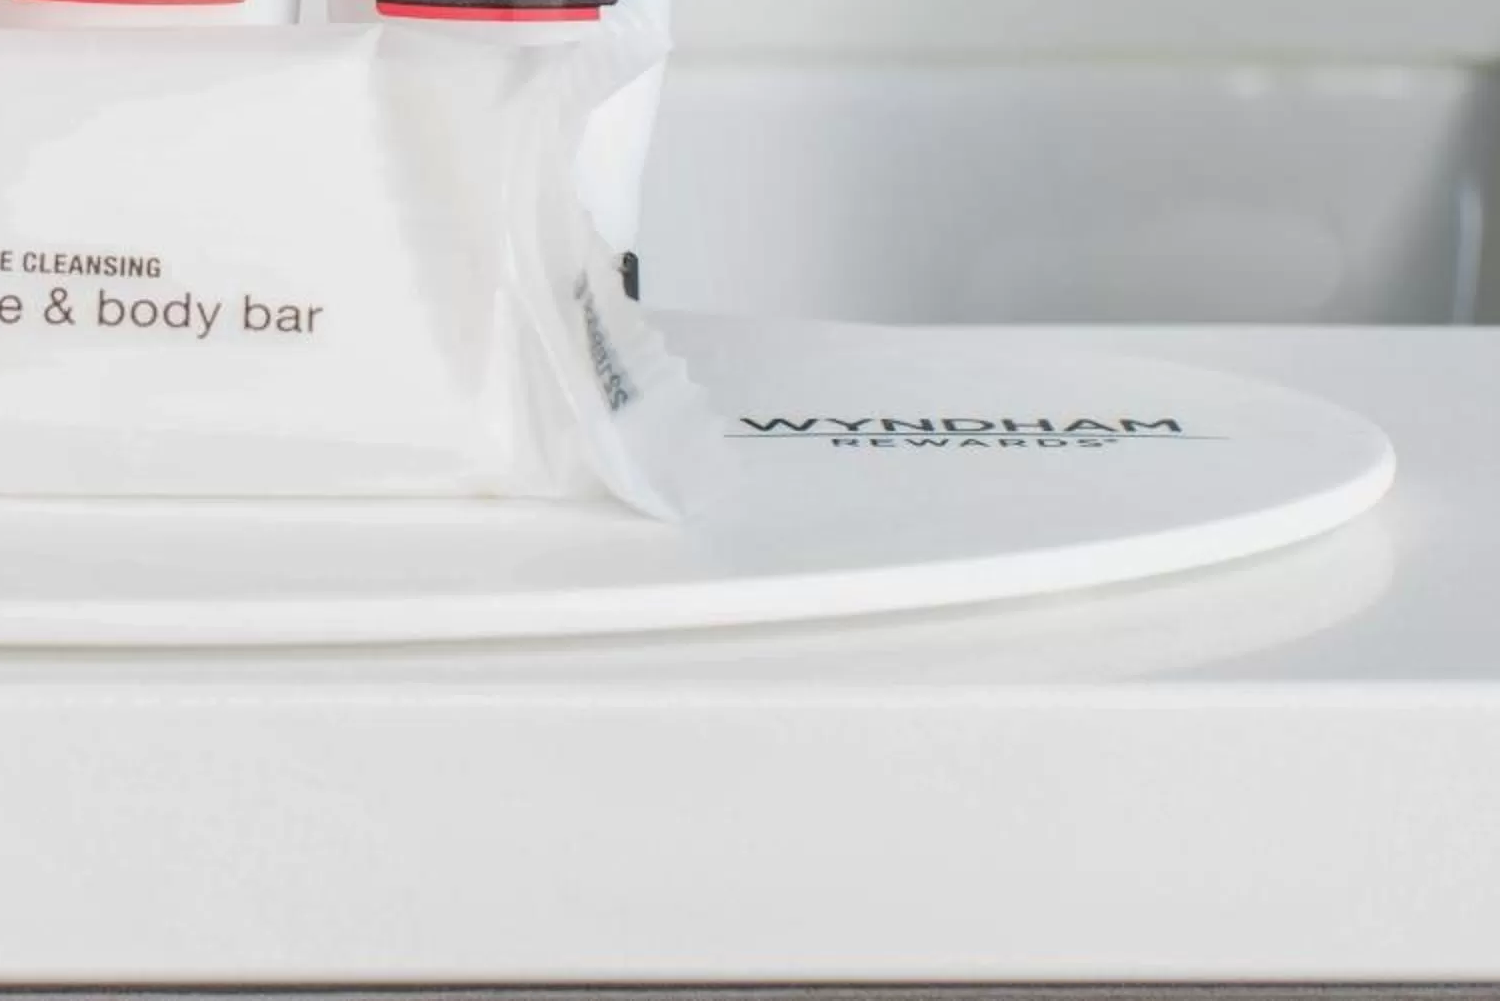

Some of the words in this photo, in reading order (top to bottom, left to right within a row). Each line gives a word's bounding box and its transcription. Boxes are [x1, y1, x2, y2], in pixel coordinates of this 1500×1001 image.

[23, 251, 162, 278] CLEANSING
[44, 287, 76, 326] &
[98, 289, 222, 339] body
[244, 294, 325, 333] bar
[740, 417, 1182, 433] WYNDHAM
[831, 437, 1107, 449] REWARDS
